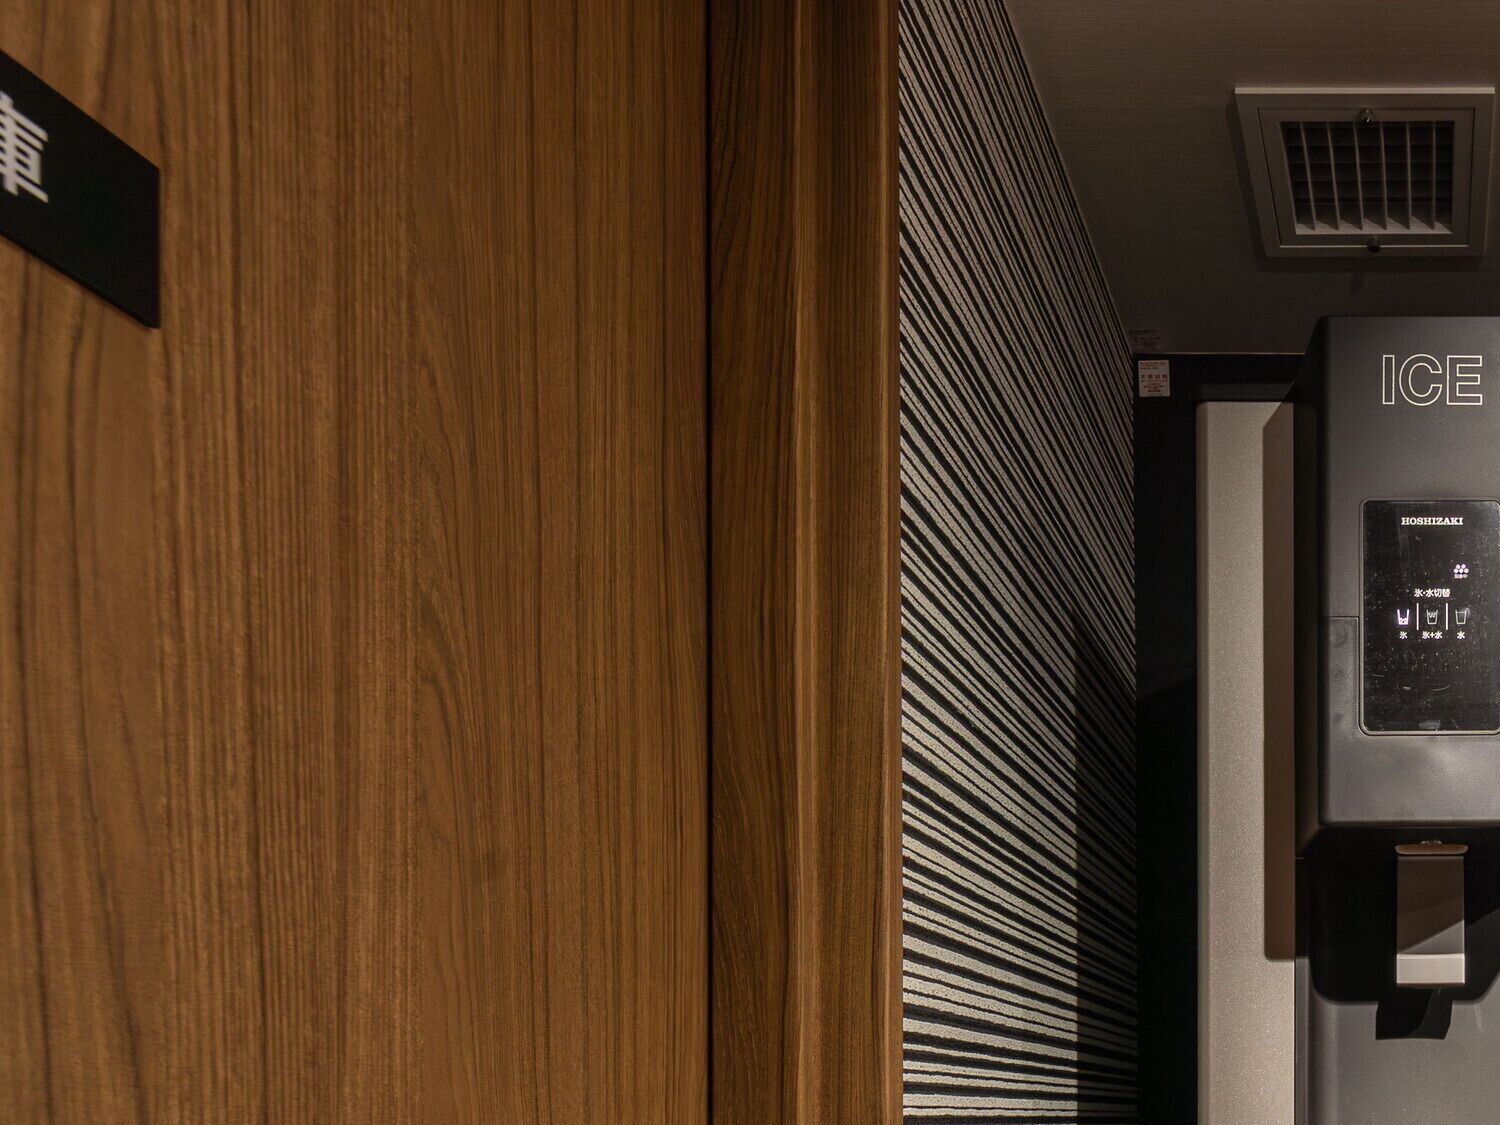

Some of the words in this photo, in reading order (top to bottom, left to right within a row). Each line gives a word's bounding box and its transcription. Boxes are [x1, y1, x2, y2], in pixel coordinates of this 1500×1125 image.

[1382, 354, 1483, 406] ICE
[1401, 517, 1464, 526] HOSHIZAKI
[1456, 631, 1466, 639] 水
